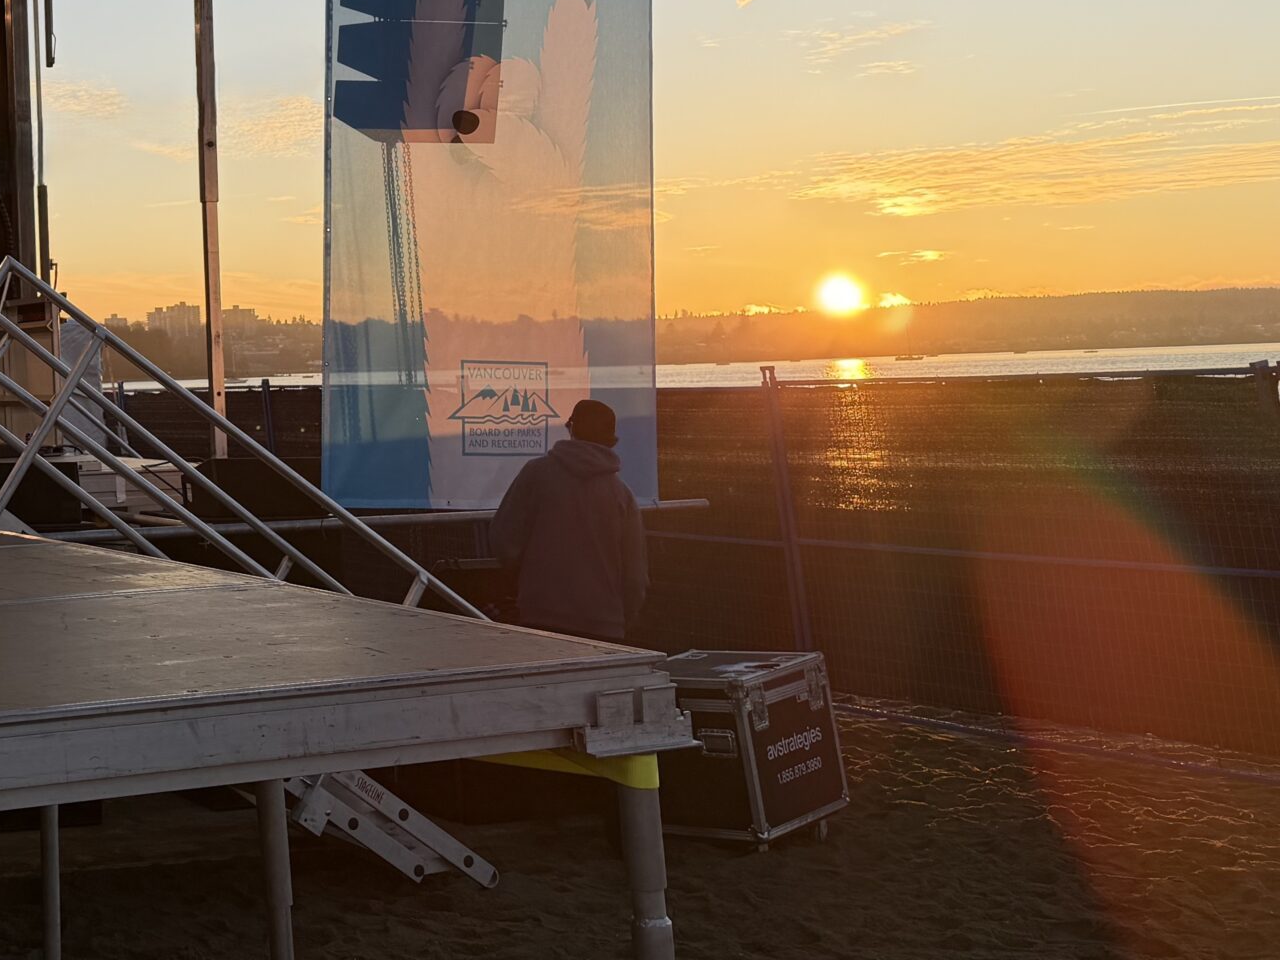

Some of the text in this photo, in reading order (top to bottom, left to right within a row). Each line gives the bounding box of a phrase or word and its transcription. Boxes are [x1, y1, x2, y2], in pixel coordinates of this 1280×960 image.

[468, 367, 543, 381] VANCOUVER
[469, 428, 542, 438] BOARD OF PARKS
[468, 439, 542, 449] AND RECREATION
[766, 725, 823, 761] avstrategies
